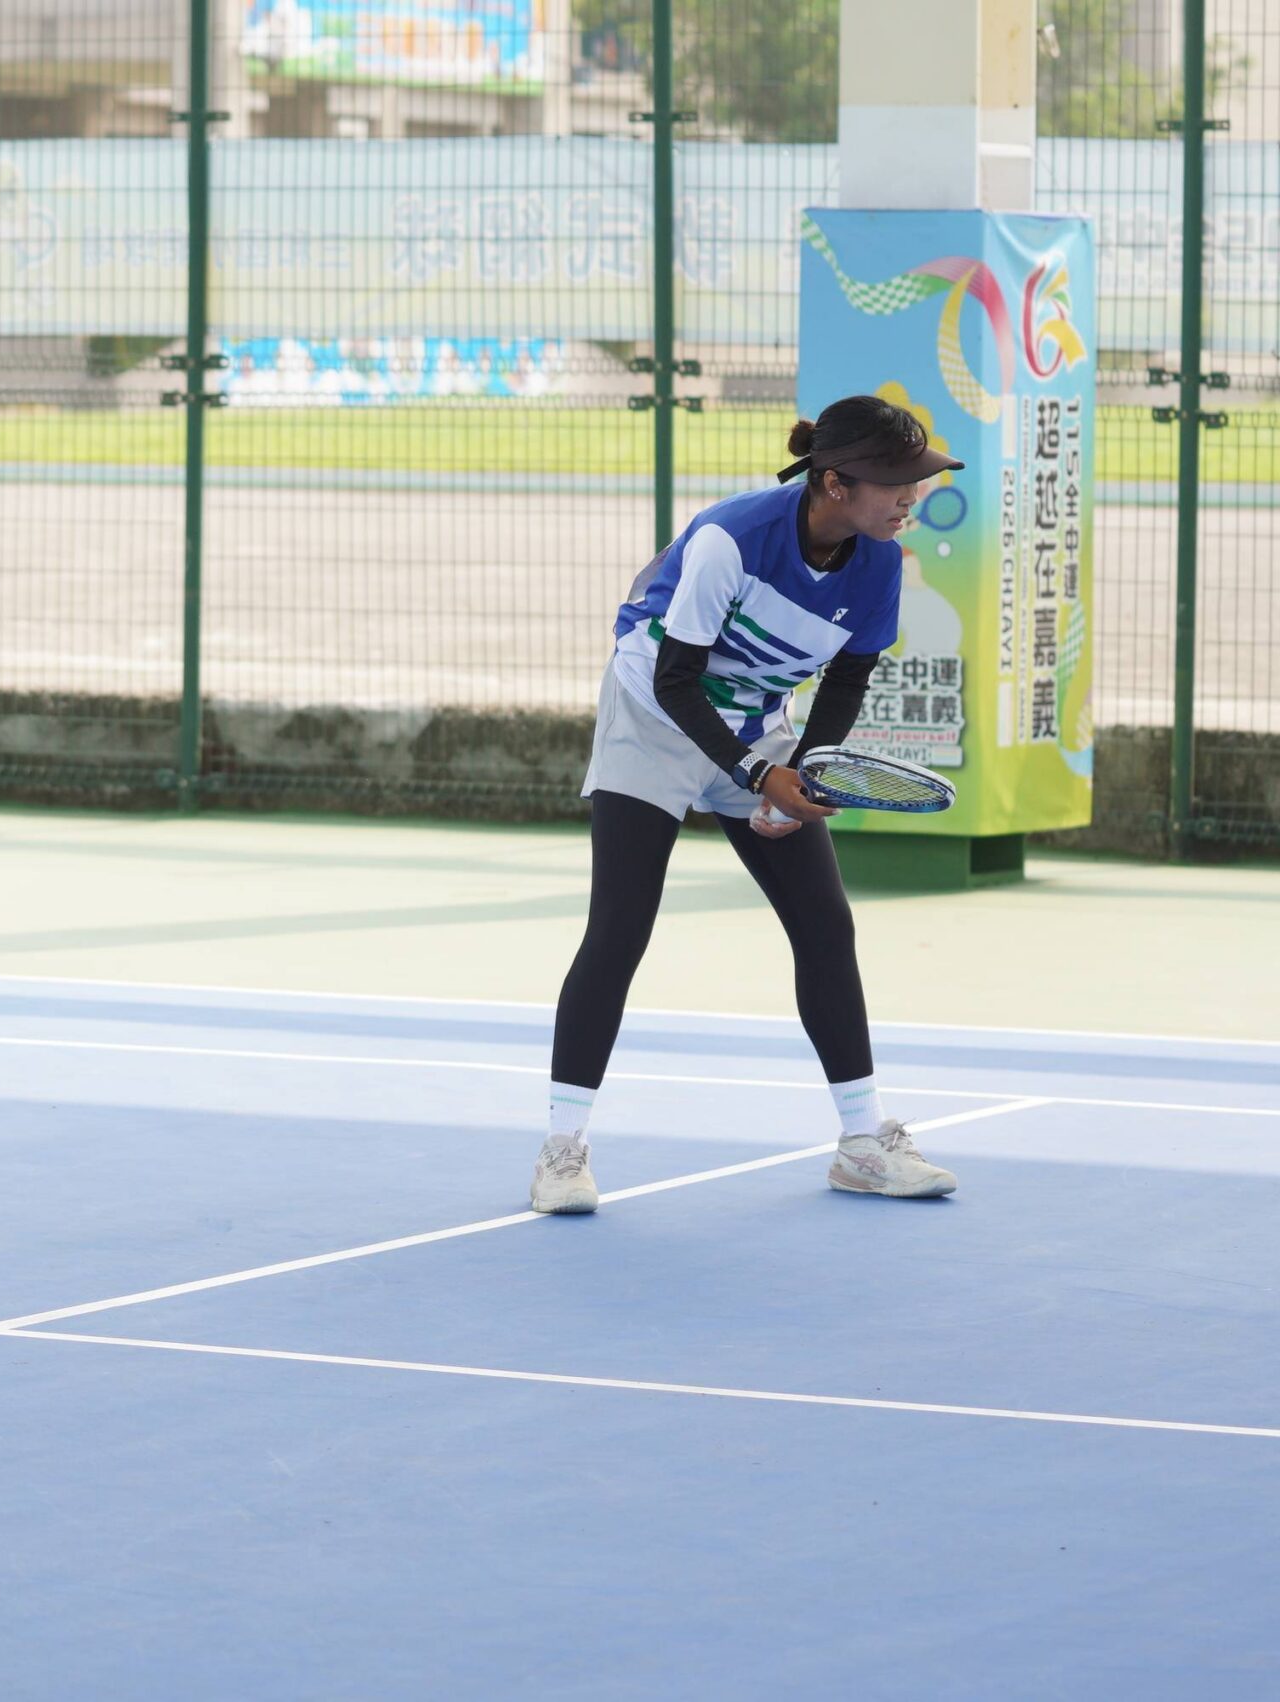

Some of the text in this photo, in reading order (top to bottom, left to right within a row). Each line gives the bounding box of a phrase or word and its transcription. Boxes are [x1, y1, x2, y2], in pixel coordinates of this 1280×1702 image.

[1064, 400, 1080, 599] 115全中運
[1001, 470, 1015, 669] 2026 CHIAYI
[1033, 400, 1060, 739] 超越在嘉義
[871, 656, 959, 687] 全中運
[879, 745, 927, 762] CHIAYI
[895, 731, 957, 742] yourself
